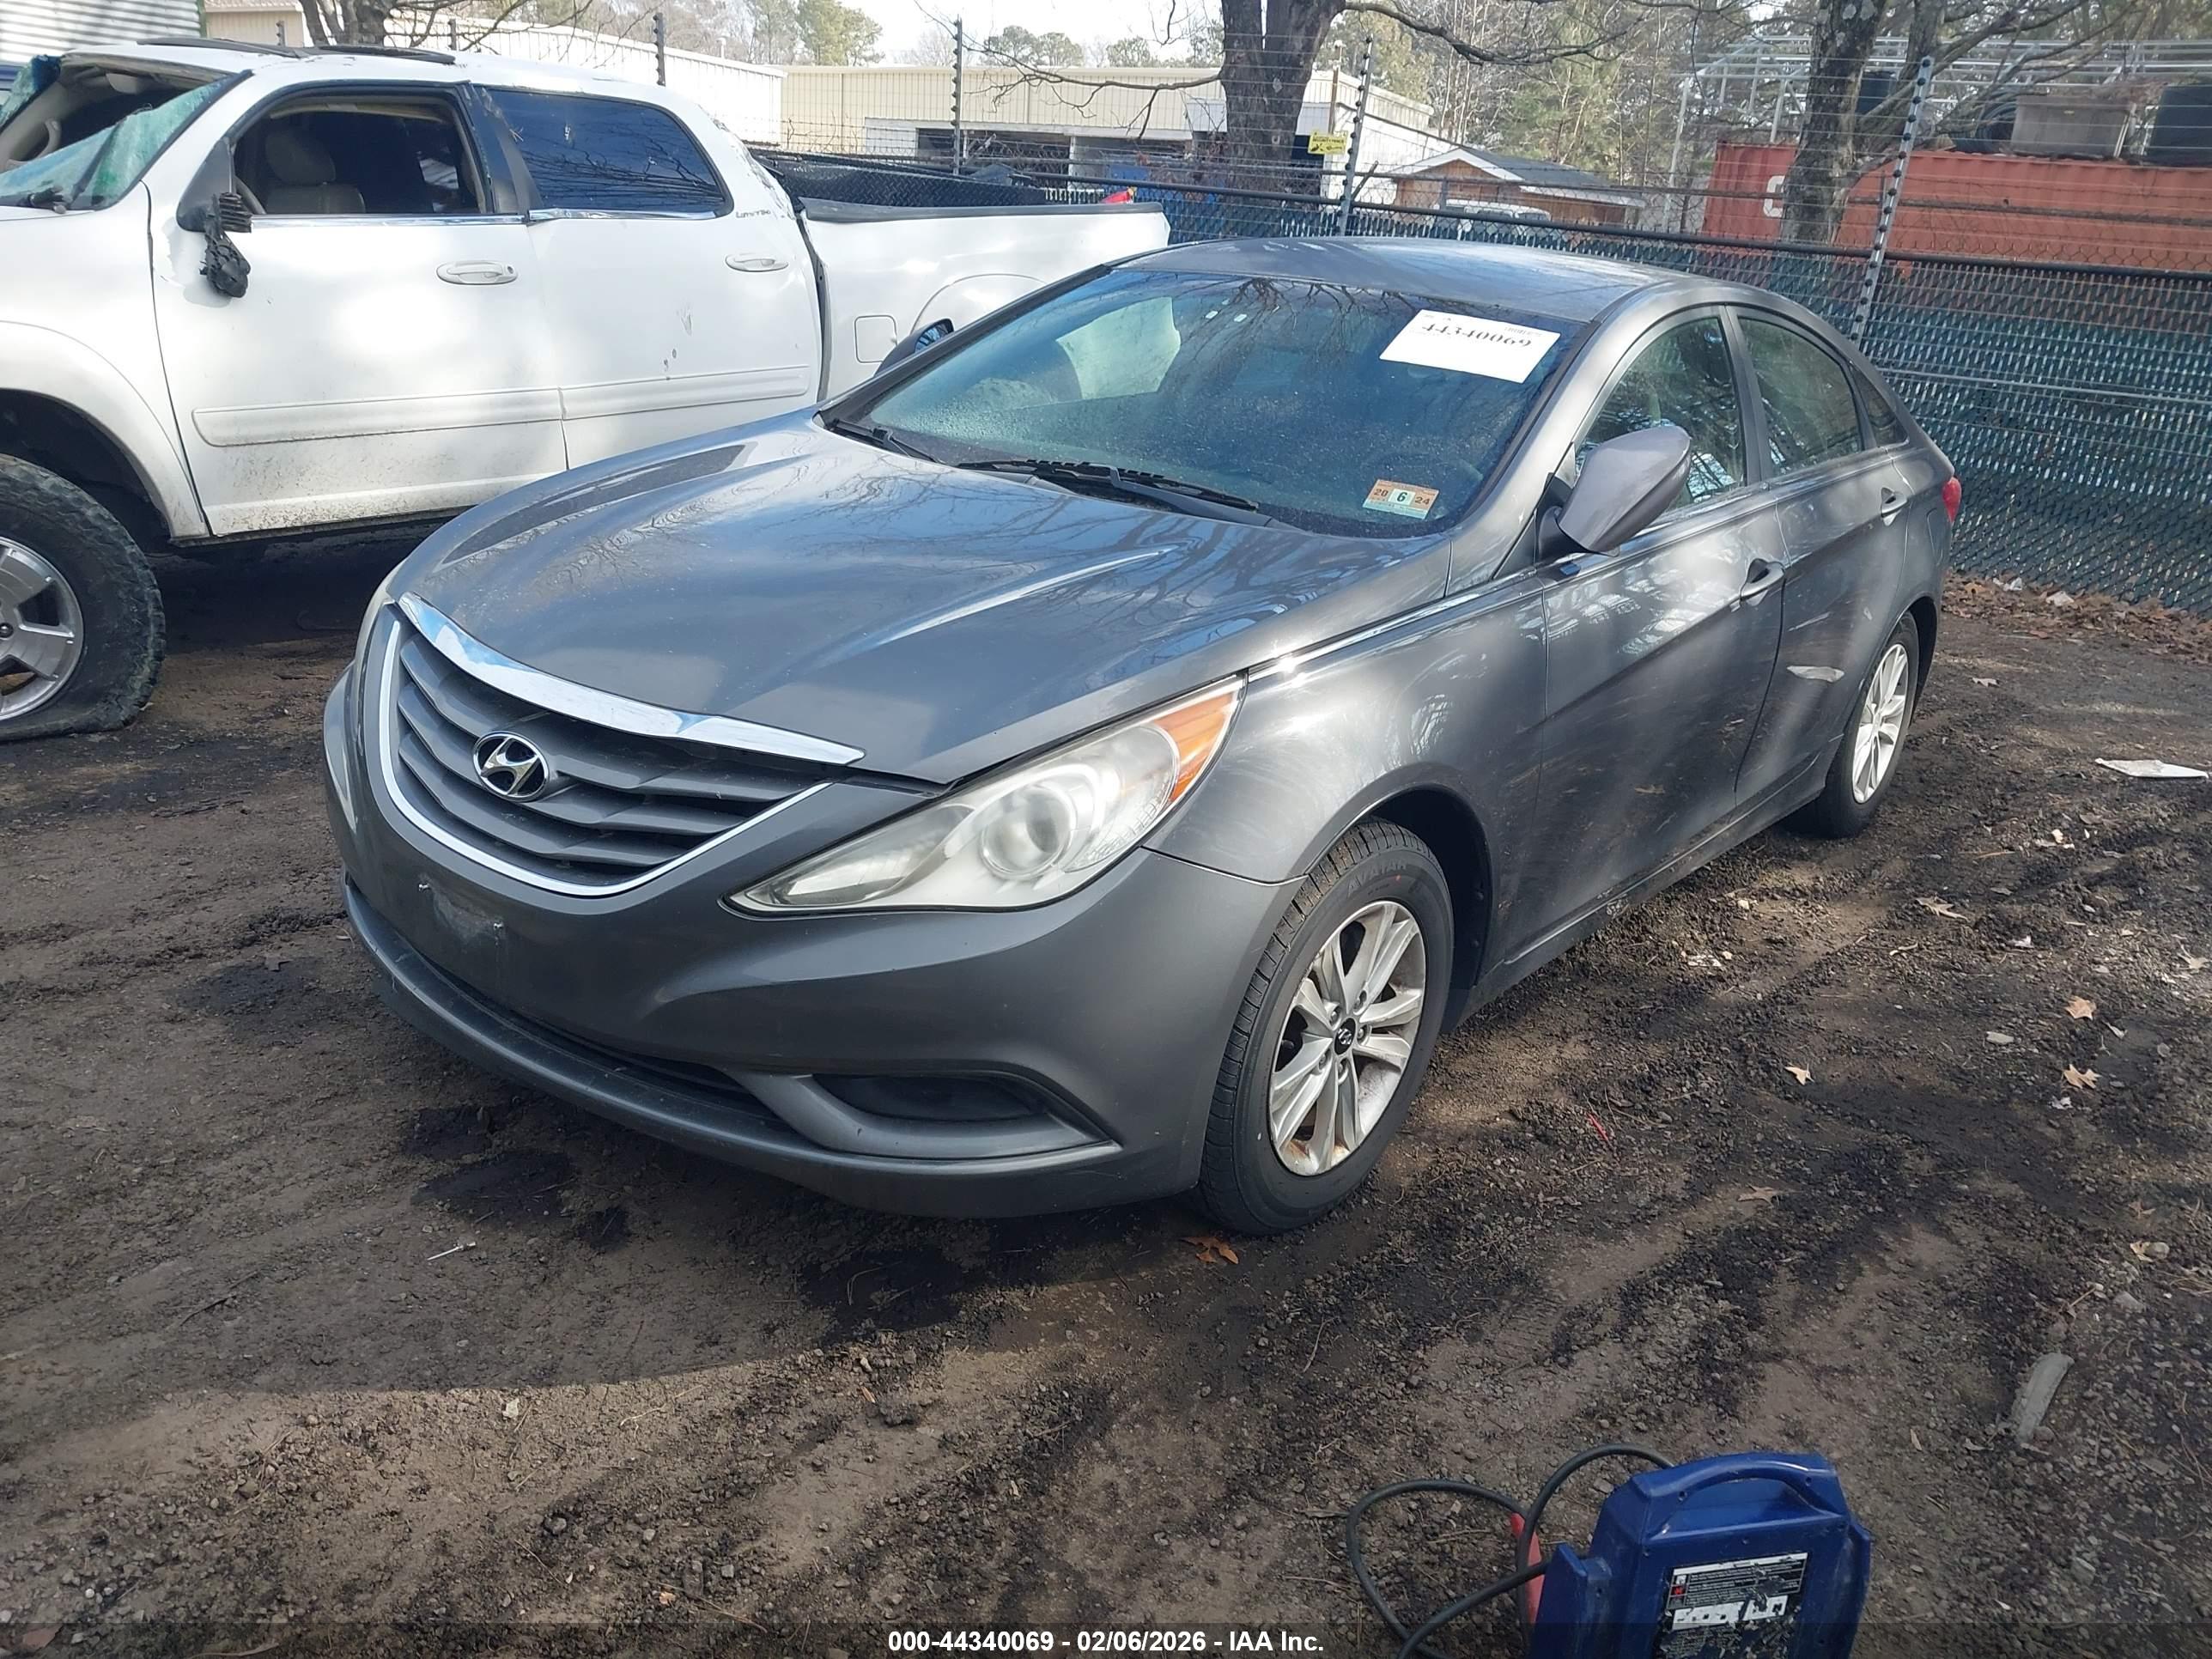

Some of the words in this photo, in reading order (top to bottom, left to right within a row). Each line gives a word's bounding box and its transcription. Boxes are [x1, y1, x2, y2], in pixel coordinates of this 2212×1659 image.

[1422, 322, 1532, 348] 44340069
[1374, 488, 1389, 497] 20
[1396, 491, 1408, 502] 6
[1414, 496, 1430, 505] 24
